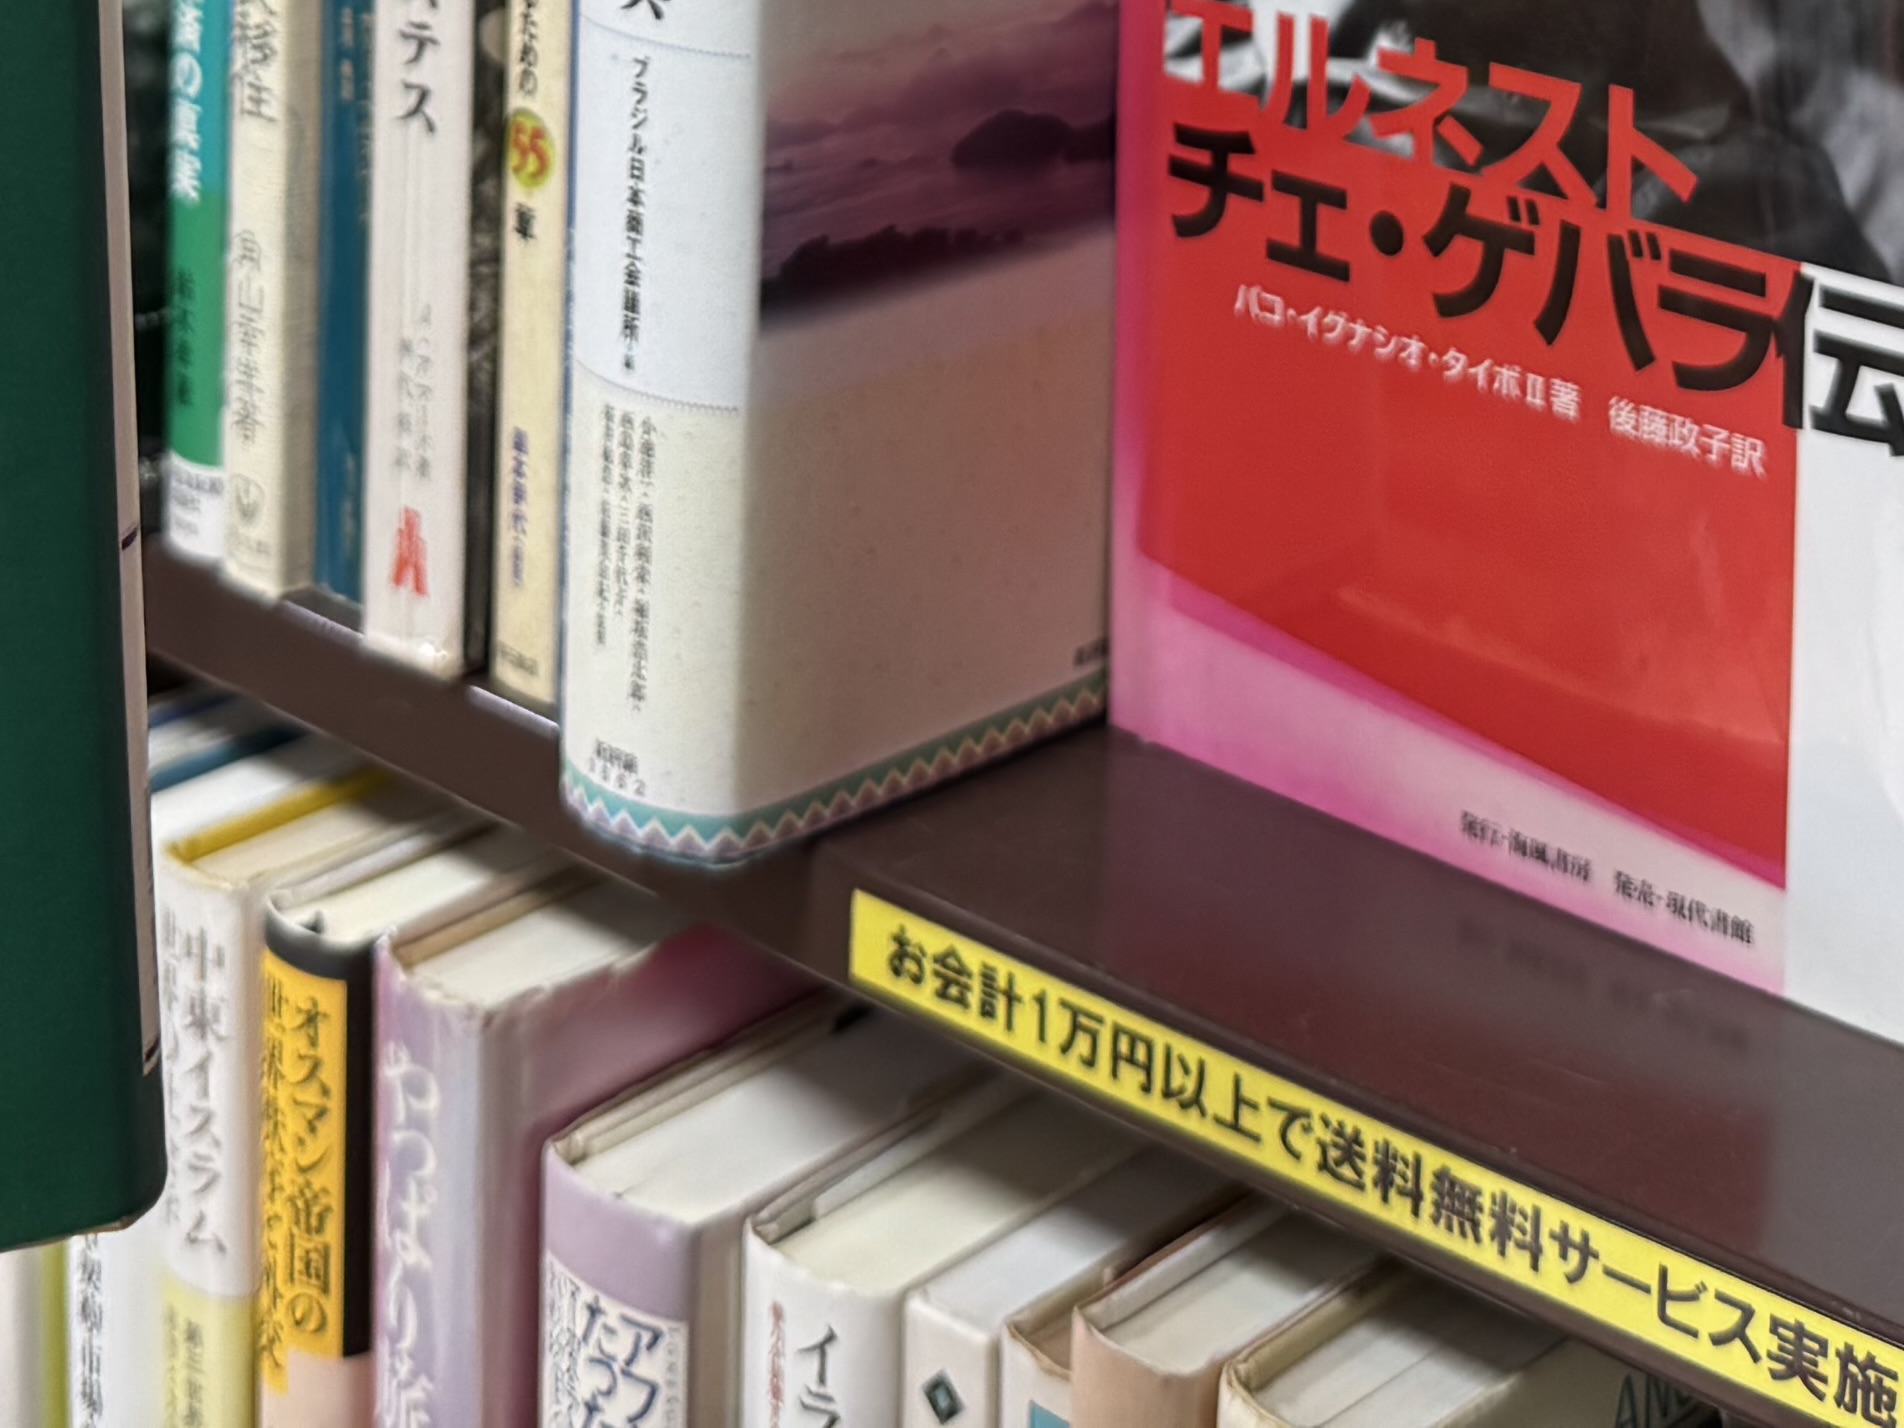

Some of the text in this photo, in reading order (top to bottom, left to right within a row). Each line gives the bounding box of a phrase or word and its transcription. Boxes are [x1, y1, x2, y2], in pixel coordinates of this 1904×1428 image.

[1607, 393, 1769, 481] 後藤政子訳
[285, 994, 336, 1336] オスマン帝国の
